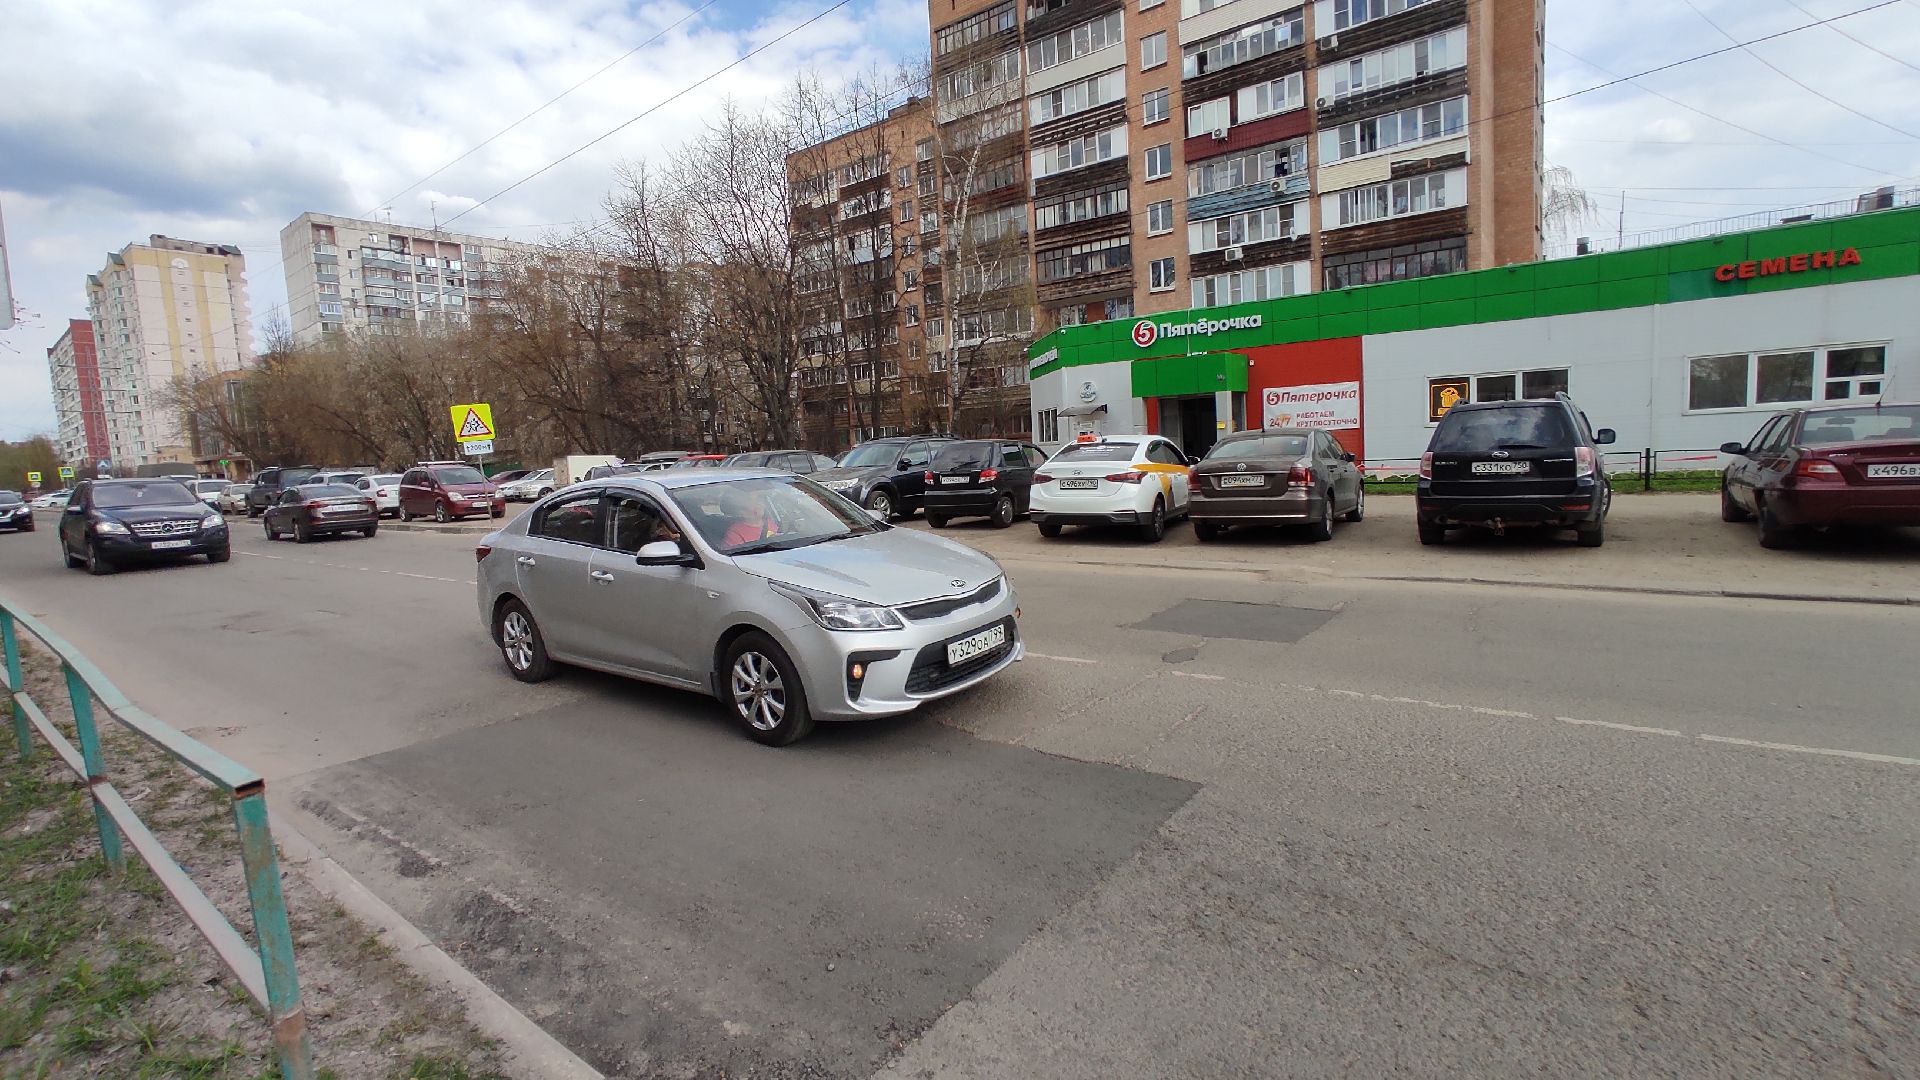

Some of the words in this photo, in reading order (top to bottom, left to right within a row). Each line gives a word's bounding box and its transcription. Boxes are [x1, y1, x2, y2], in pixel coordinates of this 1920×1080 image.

[1715, 246, 1861, 282] СЕМЕНА
[1160, 314, 1262, 338] Пятёрочка
[1281, 390, 1358, 404] Пятерочка
[1296, 411, 1335, 419] РАБОТАЕМ
[1269, 417, 1292, 428] 24/7
[1296, 418, 1358, 428] КРУГЛОСУТОЧНО
